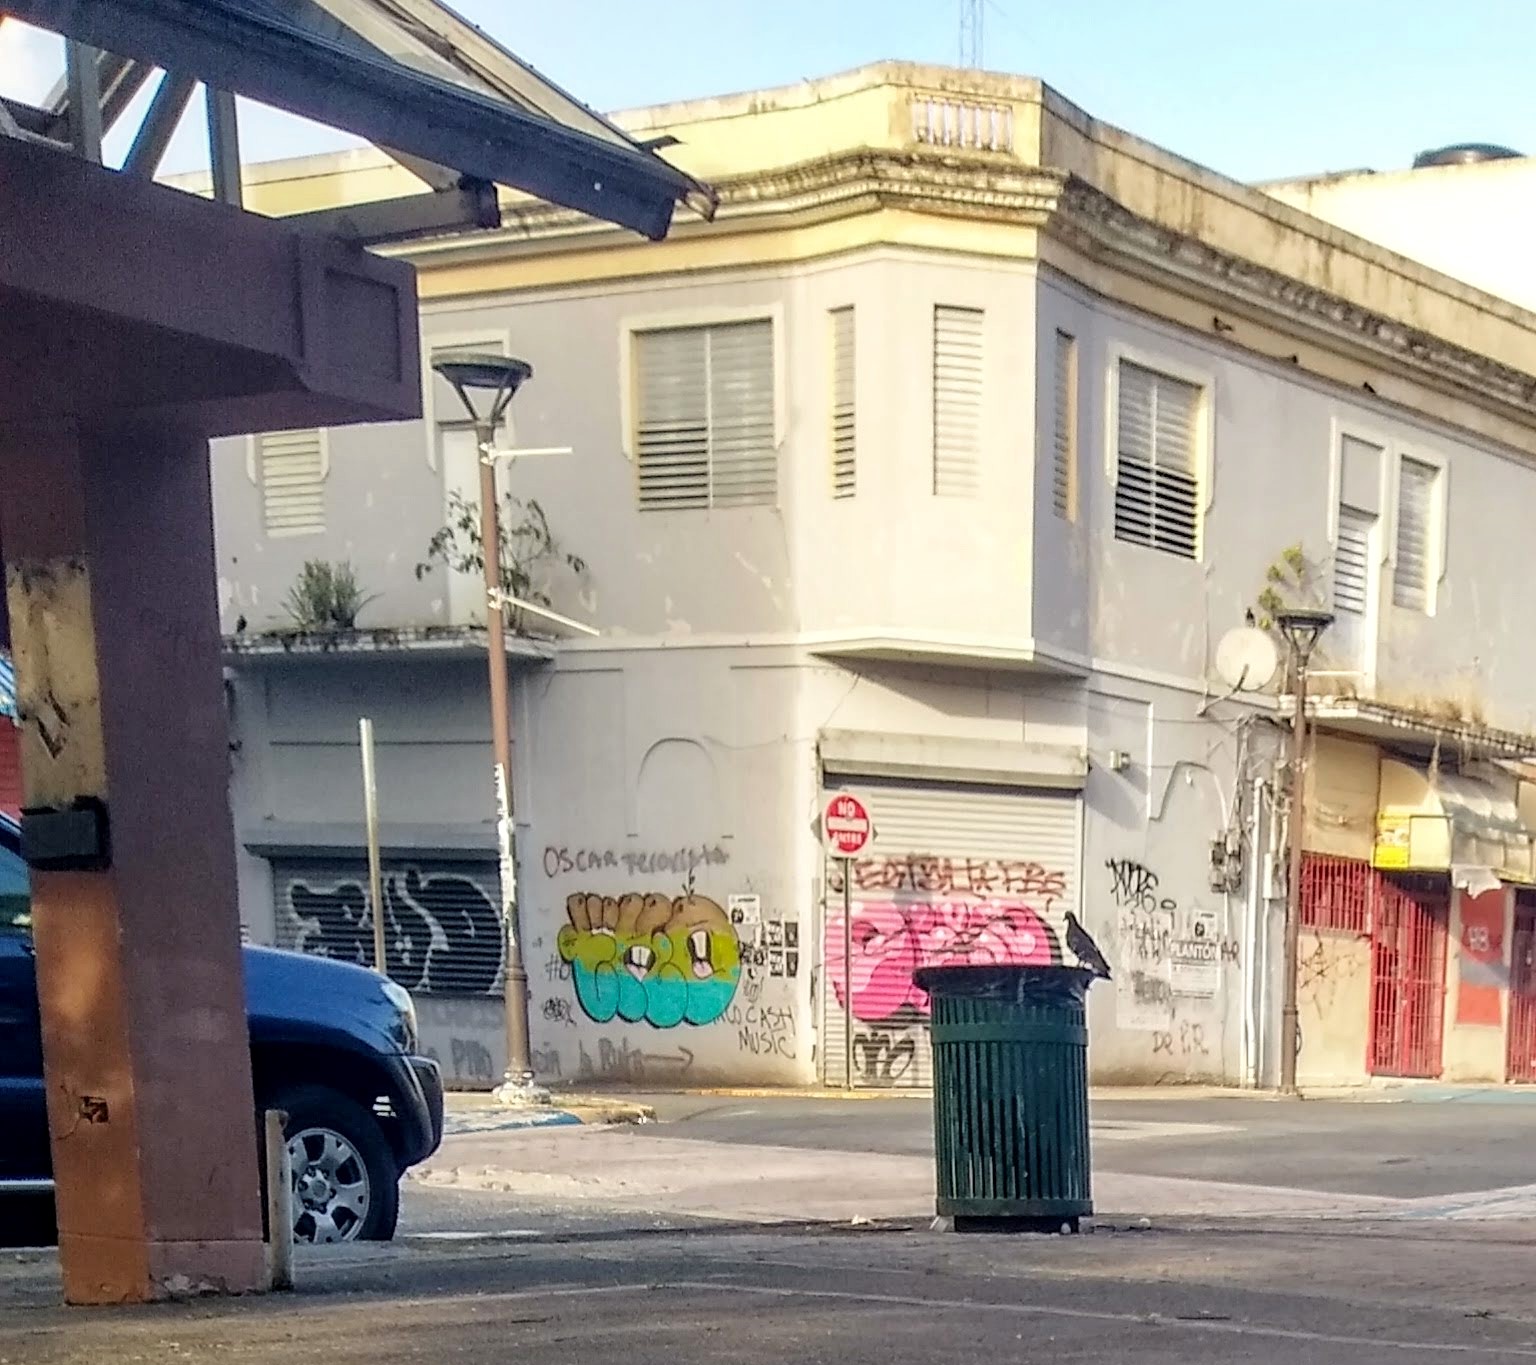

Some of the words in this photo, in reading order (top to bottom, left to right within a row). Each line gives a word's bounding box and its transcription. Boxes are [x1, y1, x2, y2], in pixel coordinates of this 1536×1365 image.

[837, 800, 857, 817] NO
[543, 845, 618, 878] OSCAR
[738, 1026, 796, 1060] MUSIC
